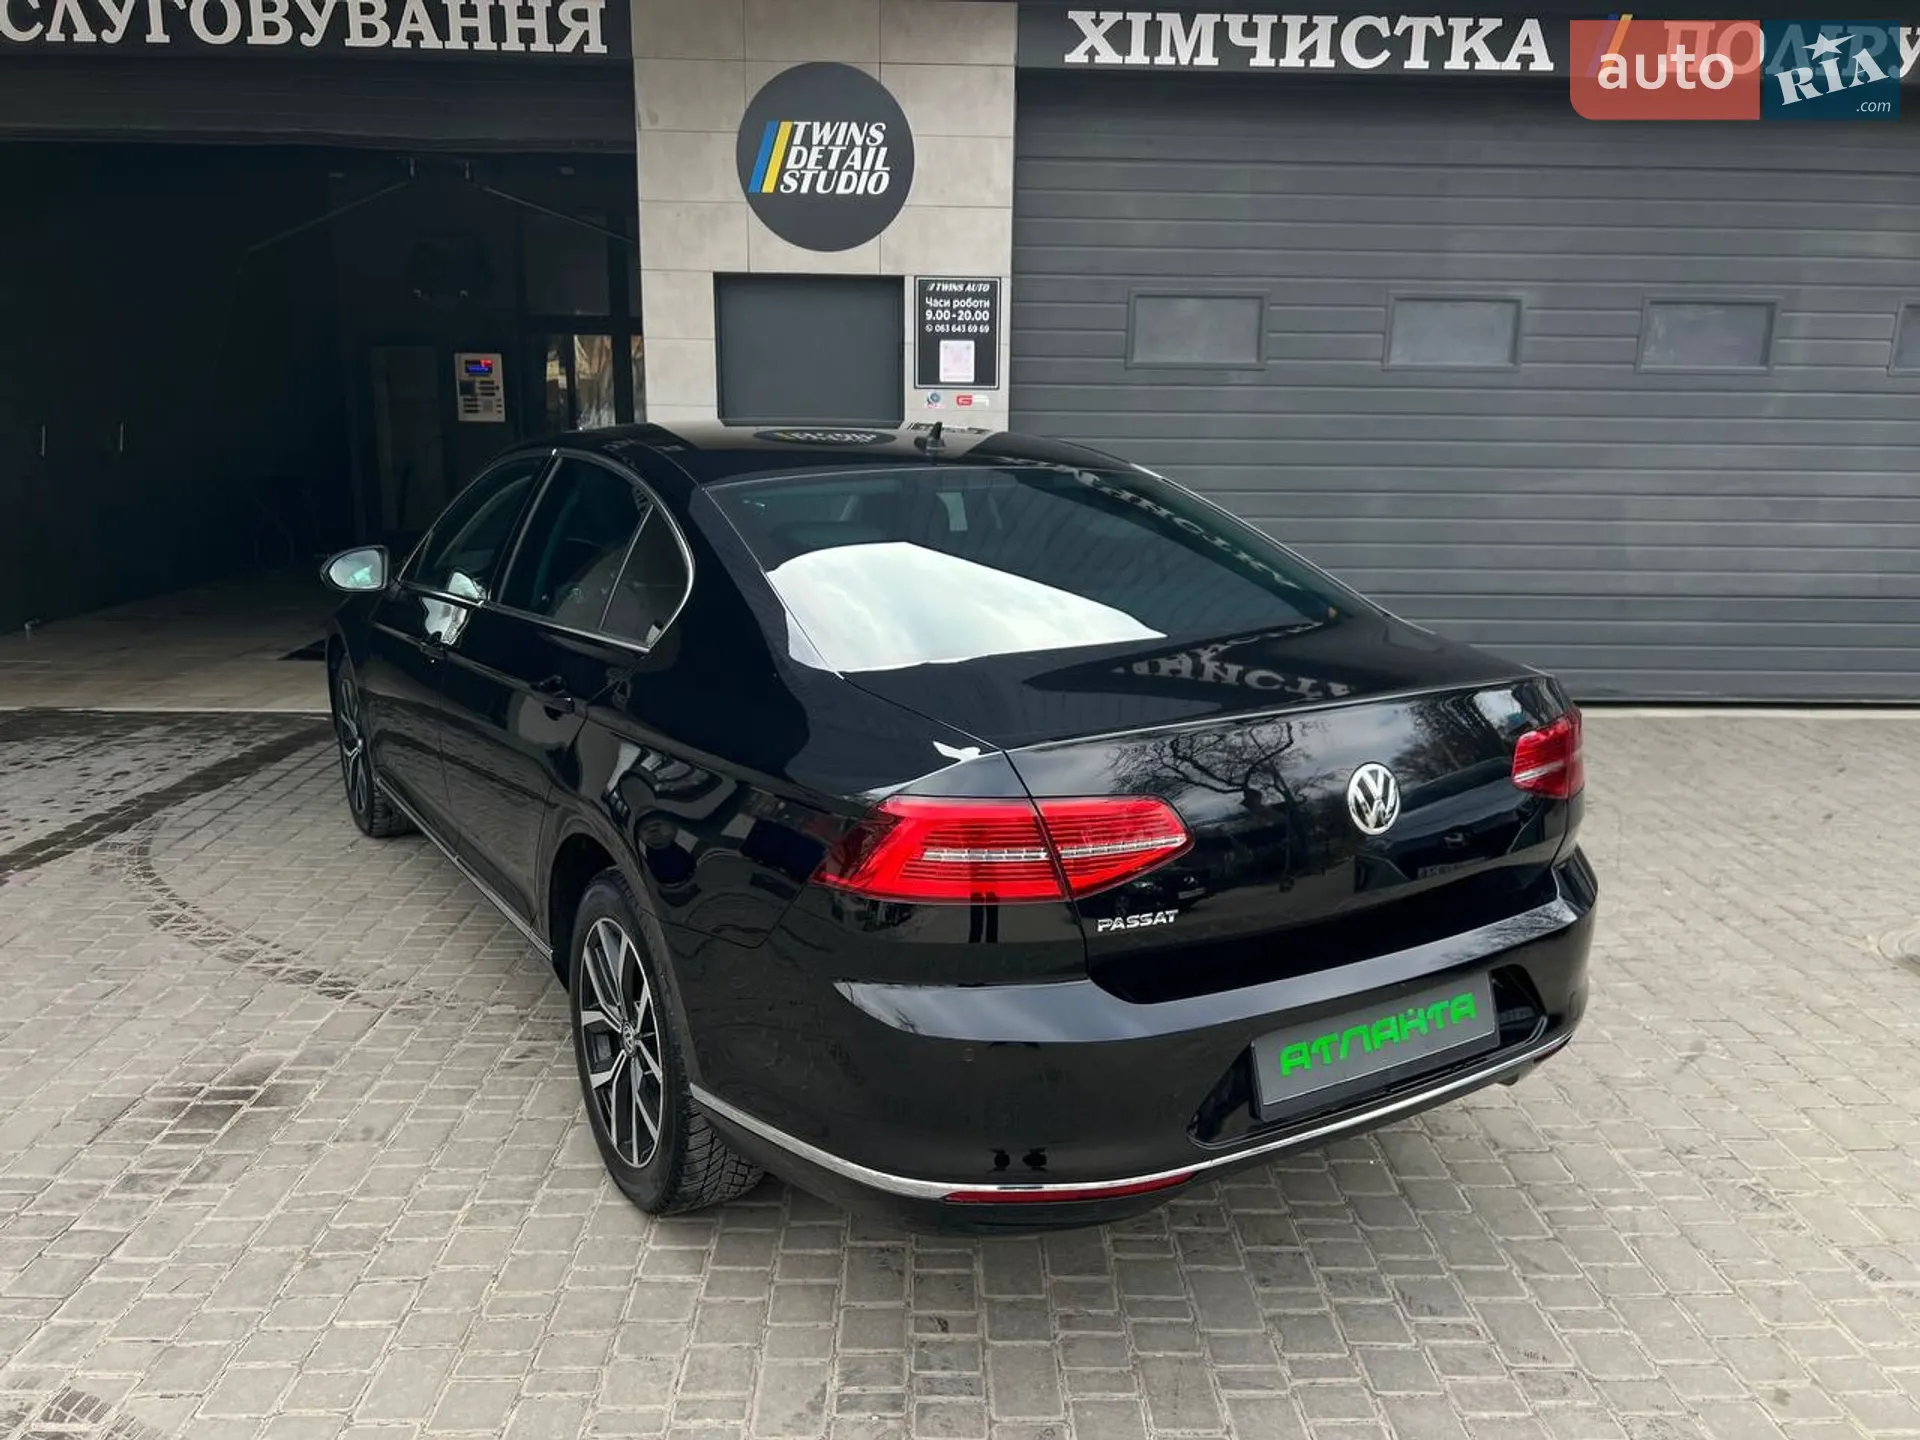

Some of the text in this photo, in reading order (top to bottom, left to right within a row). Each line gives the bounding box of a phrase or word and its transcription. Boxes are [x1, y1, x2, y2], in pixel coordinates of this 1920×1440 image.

[0, 0, 608, 54] СЛУГОВУВАННЯ
[1064, 10, 1554, 71] ХІМЧИСТКА
[792, 121, 887, 146] TWINS
[785, 146, 891, 171] DETAIL
[780, 170, 890, 195] STUDIO
[965, 283, 990, 293] AUTO
[925, 296, 990, 309] Часи роботи
[1097, 909, 1179, 932] PASSAT
